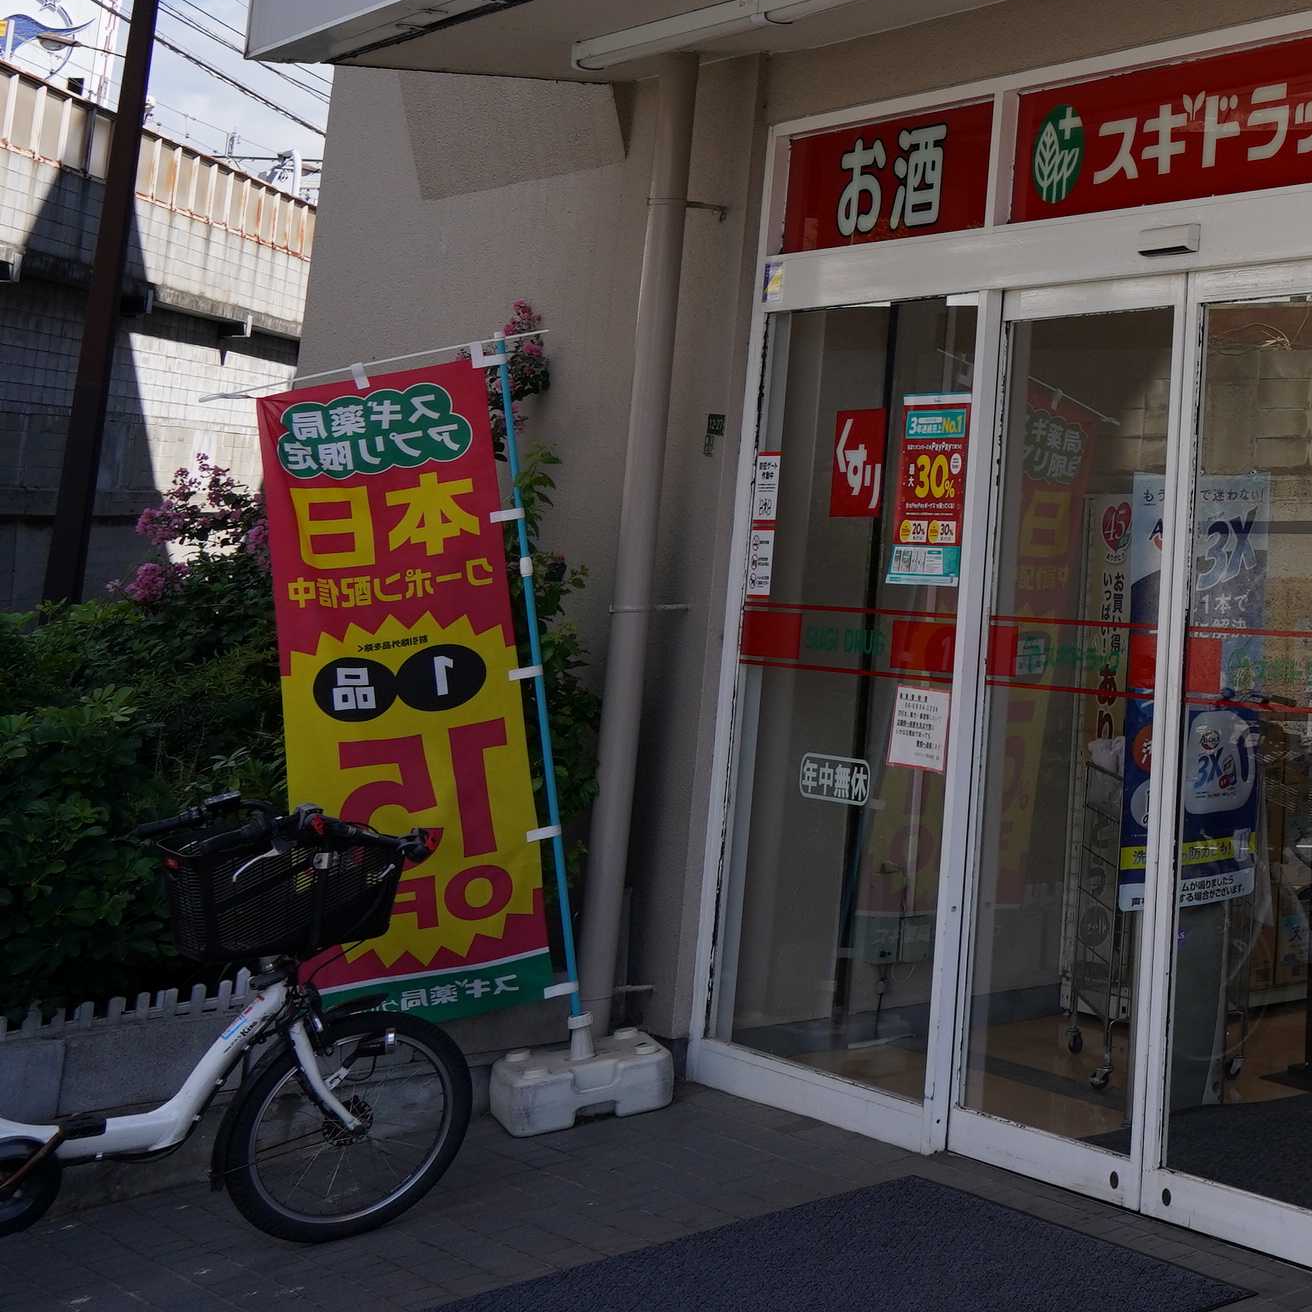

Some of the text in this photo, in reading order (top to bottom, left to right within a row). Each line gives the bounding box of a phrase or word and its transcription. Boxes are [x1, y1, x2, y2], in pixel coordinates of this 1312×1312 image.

[837, 124, 948, 237] お酒
[836, 418, 882, 510] くすり
[802, 759, 868, 801] 年中無休
